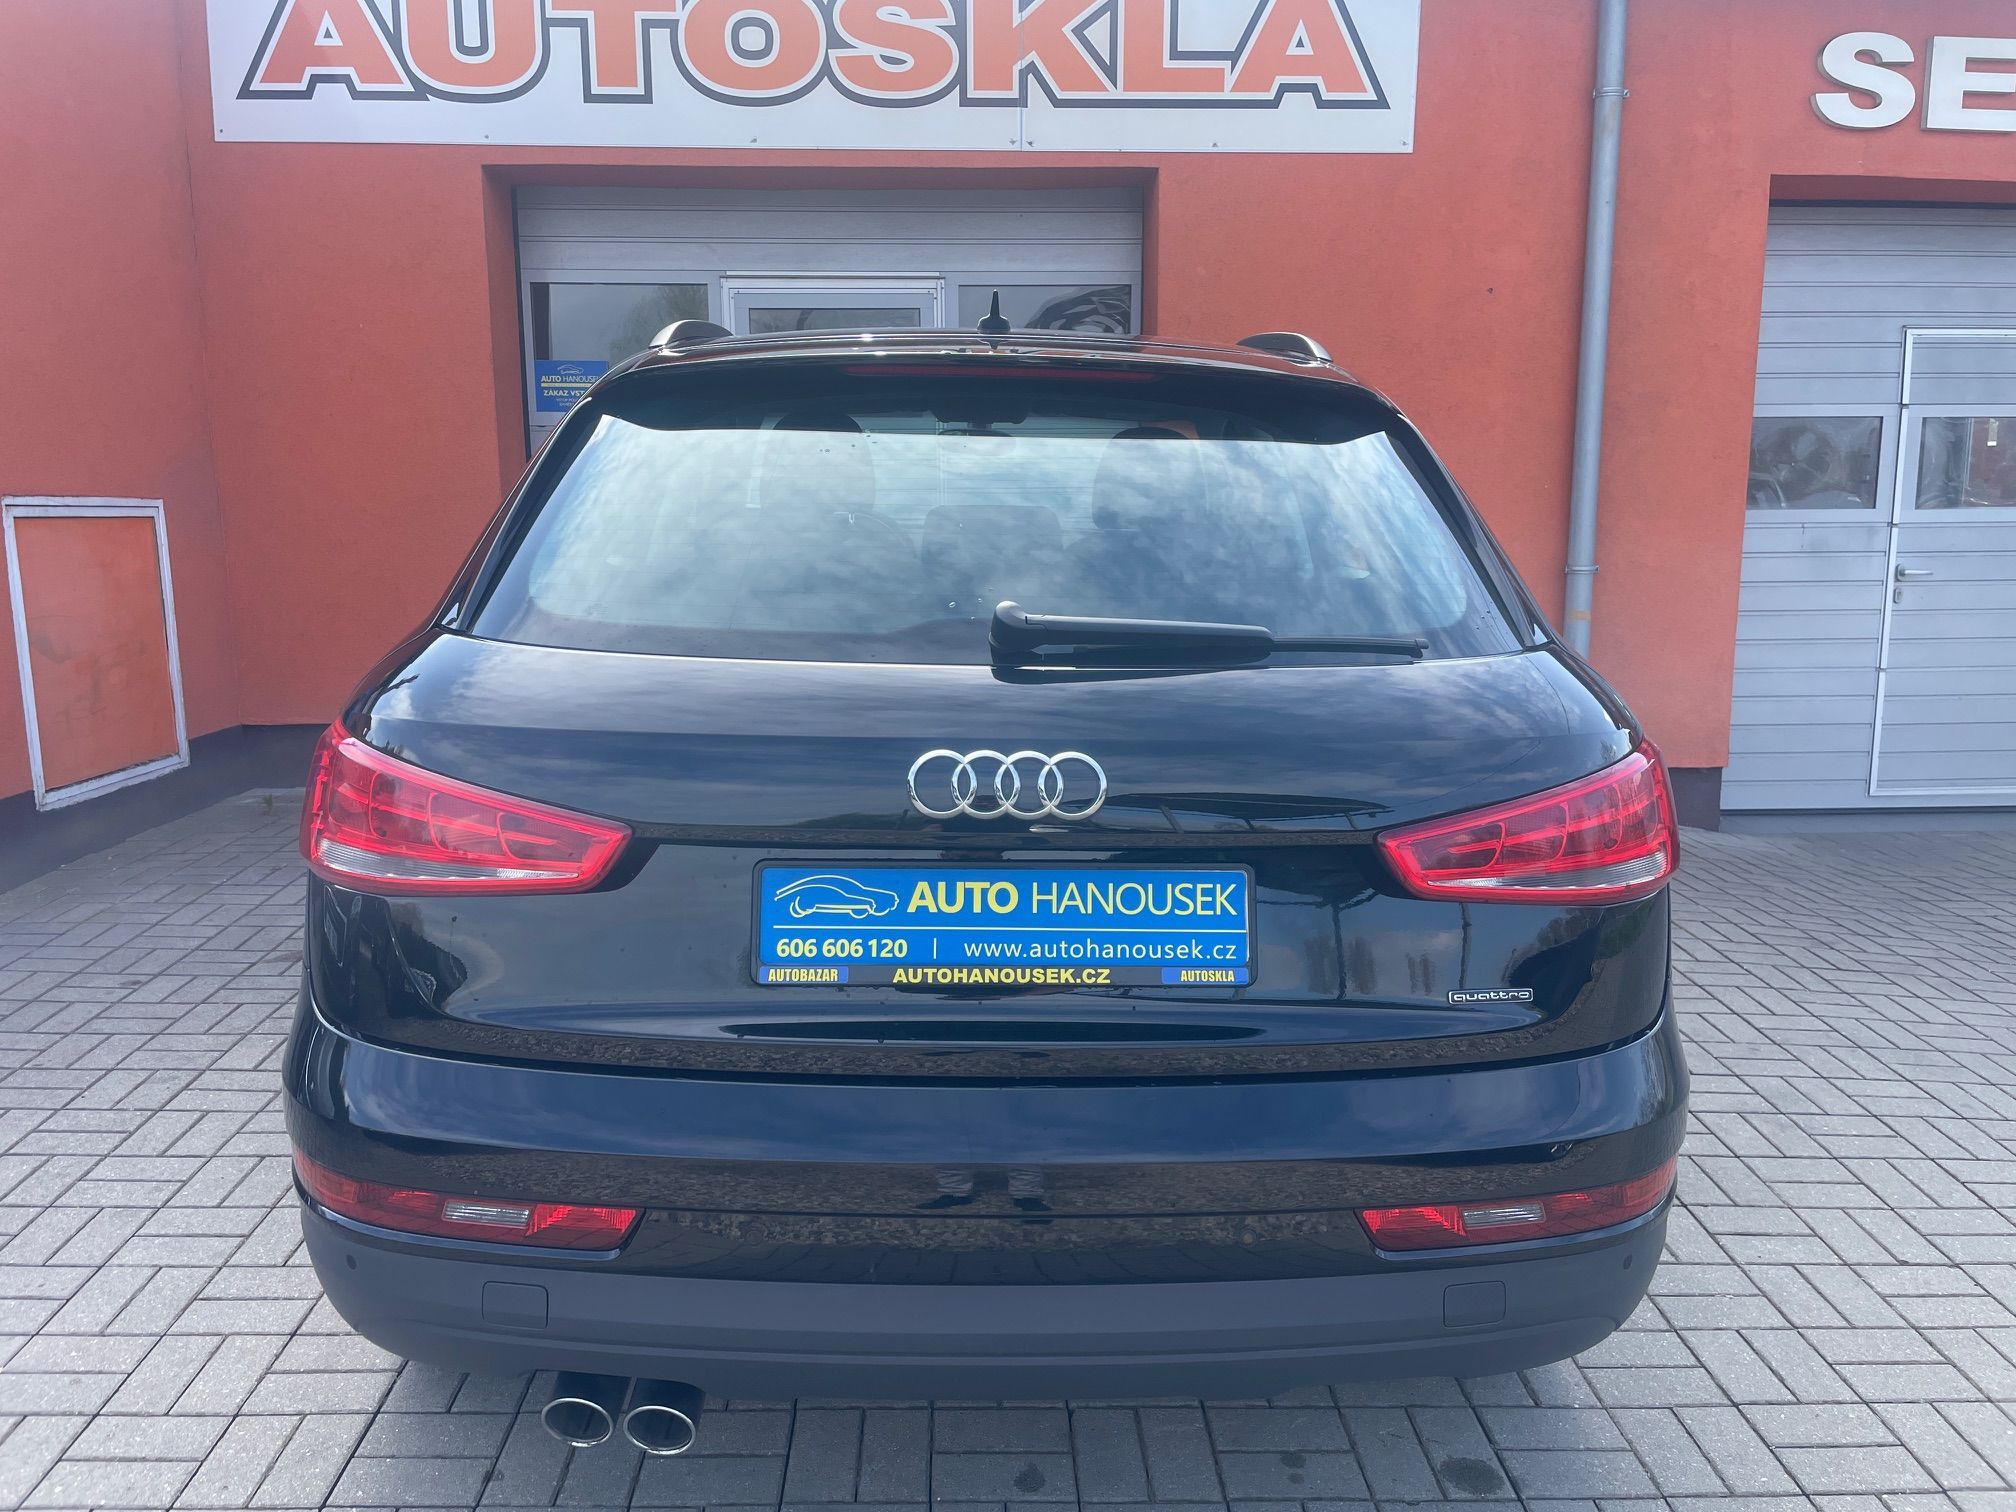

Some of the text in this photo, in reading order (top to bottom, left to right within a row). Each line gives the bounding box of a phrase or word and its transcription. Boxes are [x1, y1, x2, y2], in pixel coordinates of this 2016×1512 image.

[236, 0, 1391, 109] AUTOSKLA
[1810, 31, 2016, 132] SE
[906, 881, 1238, 916] AUTO HANOUSEK
[776, 938, 1237, 959] 606 606 120 www.autohanousek.cz
[768, 968, 838, 982] AUTOBAZAR
[893, 968, 1111, 984] AUTOHANOUSEK.CZ
[1180, 969, 1235, 982] AUTOSKLA
[1453, 991, 1530, 1003] quattro
